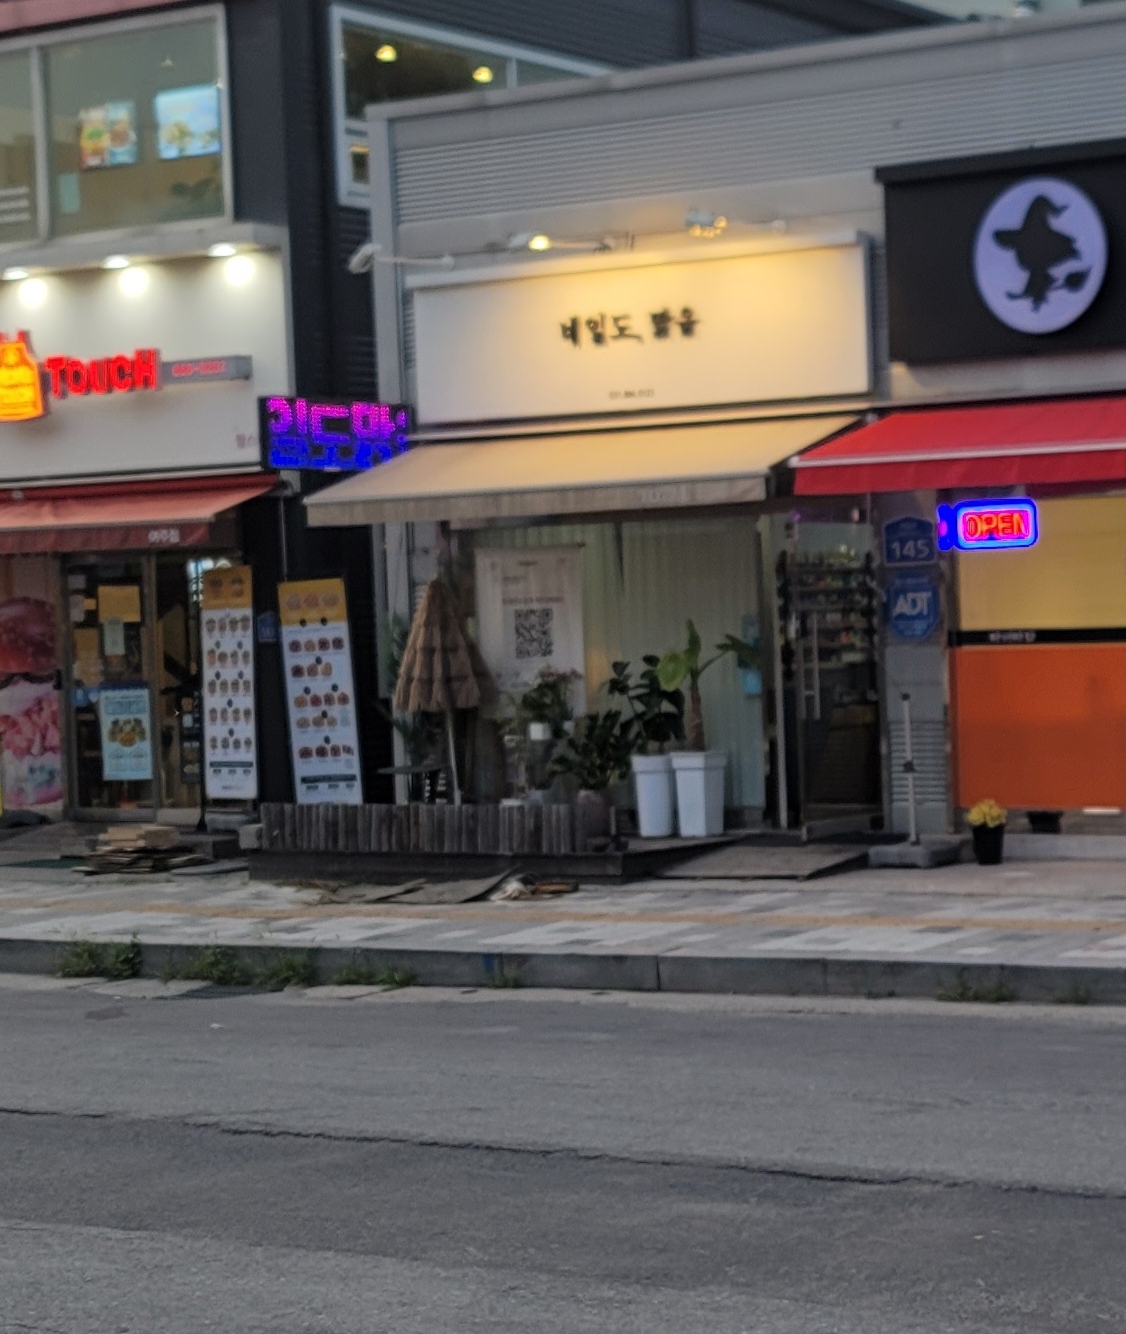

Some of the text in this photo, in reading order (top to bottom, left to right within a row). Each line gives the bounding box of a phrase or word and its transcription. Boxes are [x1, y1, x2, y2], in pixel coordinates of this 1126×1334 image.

[45, 349, 158, 399] TOUCH
[965, 512, 1029, 540] OPEN
[891, 539, 930, 559] 145
[892, 591, 932, 617] ADT
